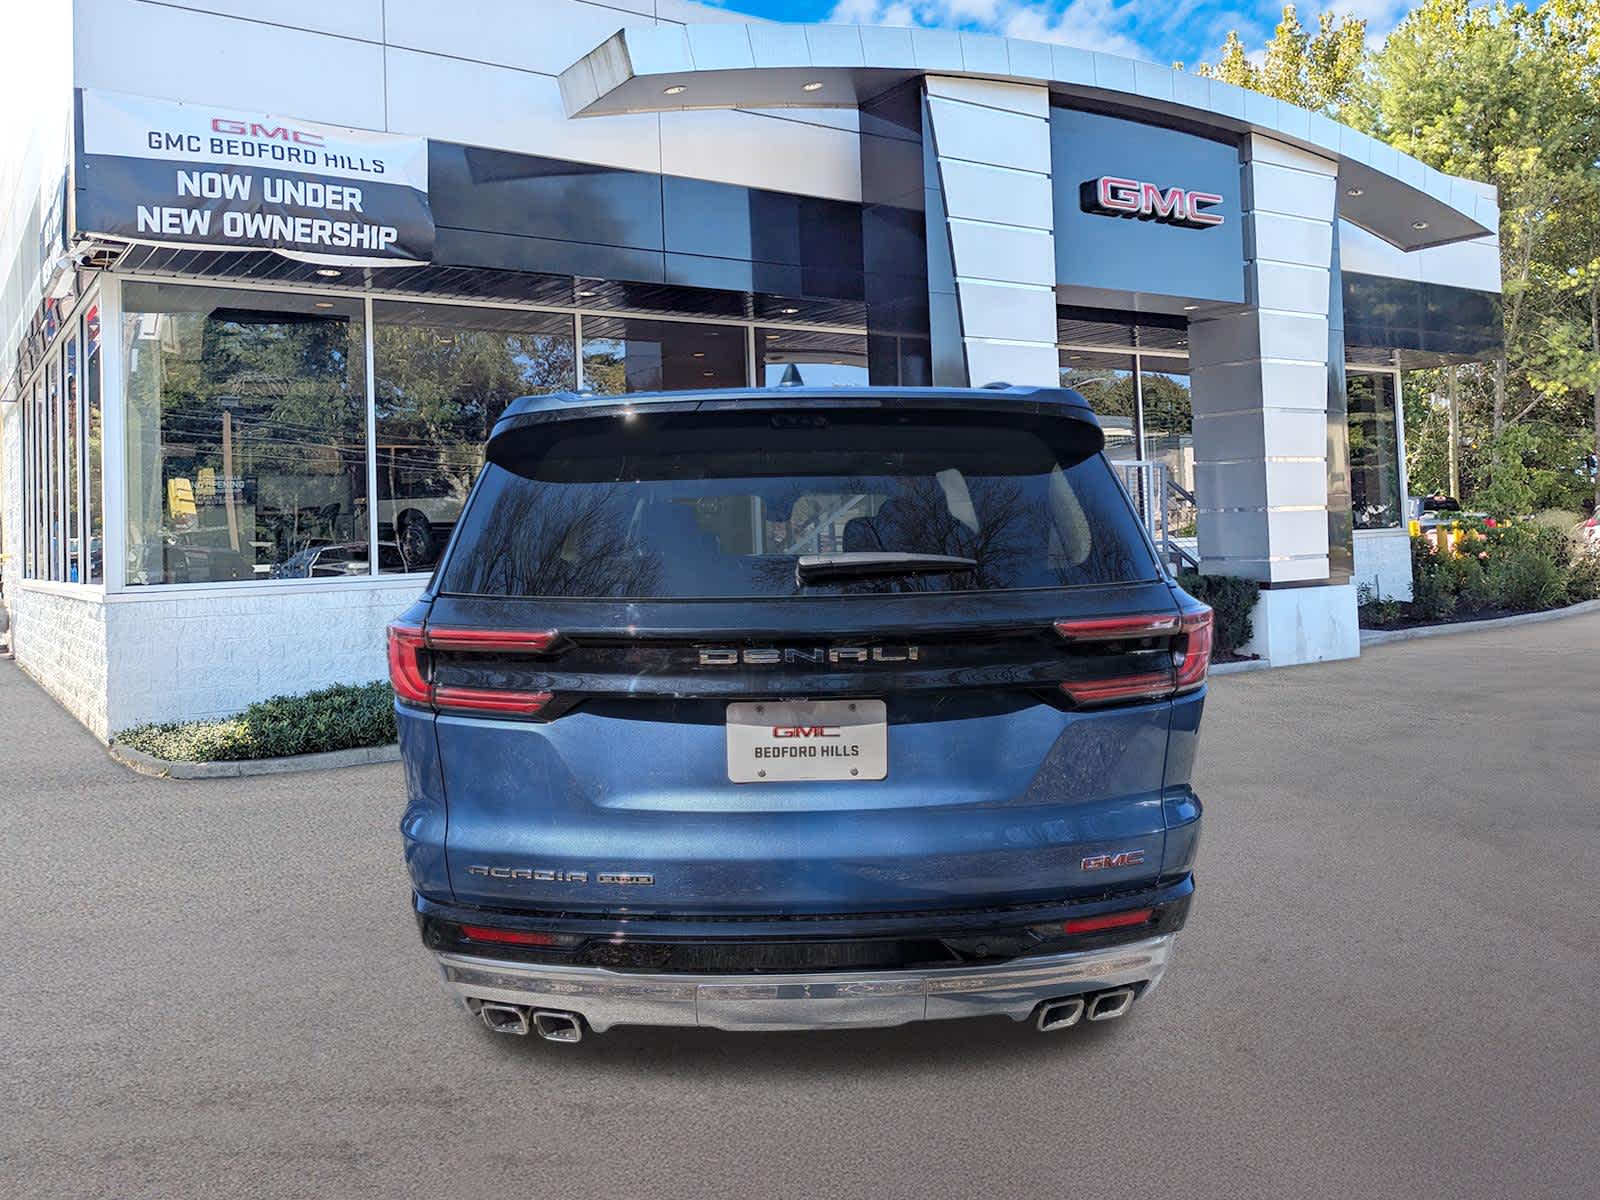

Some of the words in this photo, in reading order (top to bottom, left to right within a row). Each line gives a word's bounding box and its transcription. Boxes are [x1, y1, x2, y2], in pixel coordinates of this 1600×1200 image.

[210, 118, 326, 147] GMC
[148, 131, 201, 152] GMC
[210, 138, 317, 165] BEDFORD
[324, 153, 385, 173] HILLS
[177, 170, 252, 200] NOW
[263, 177, 363, 213] UNDER
[1098, 176, 1225, 225] GMC
[137, 205, 211, 236] NEW
[223, 211, 398, 250] OWNERSHIP
[700, 647, 919, 665] DENALI
[772, 726, 841, 738] GMC
[755, 746, 817, 758] BEDFORD
[821, 745, 859, 757] HILLS
[1081, 849, 1145, 871] GMC
[467, 865, 589, 882] ACADIA
